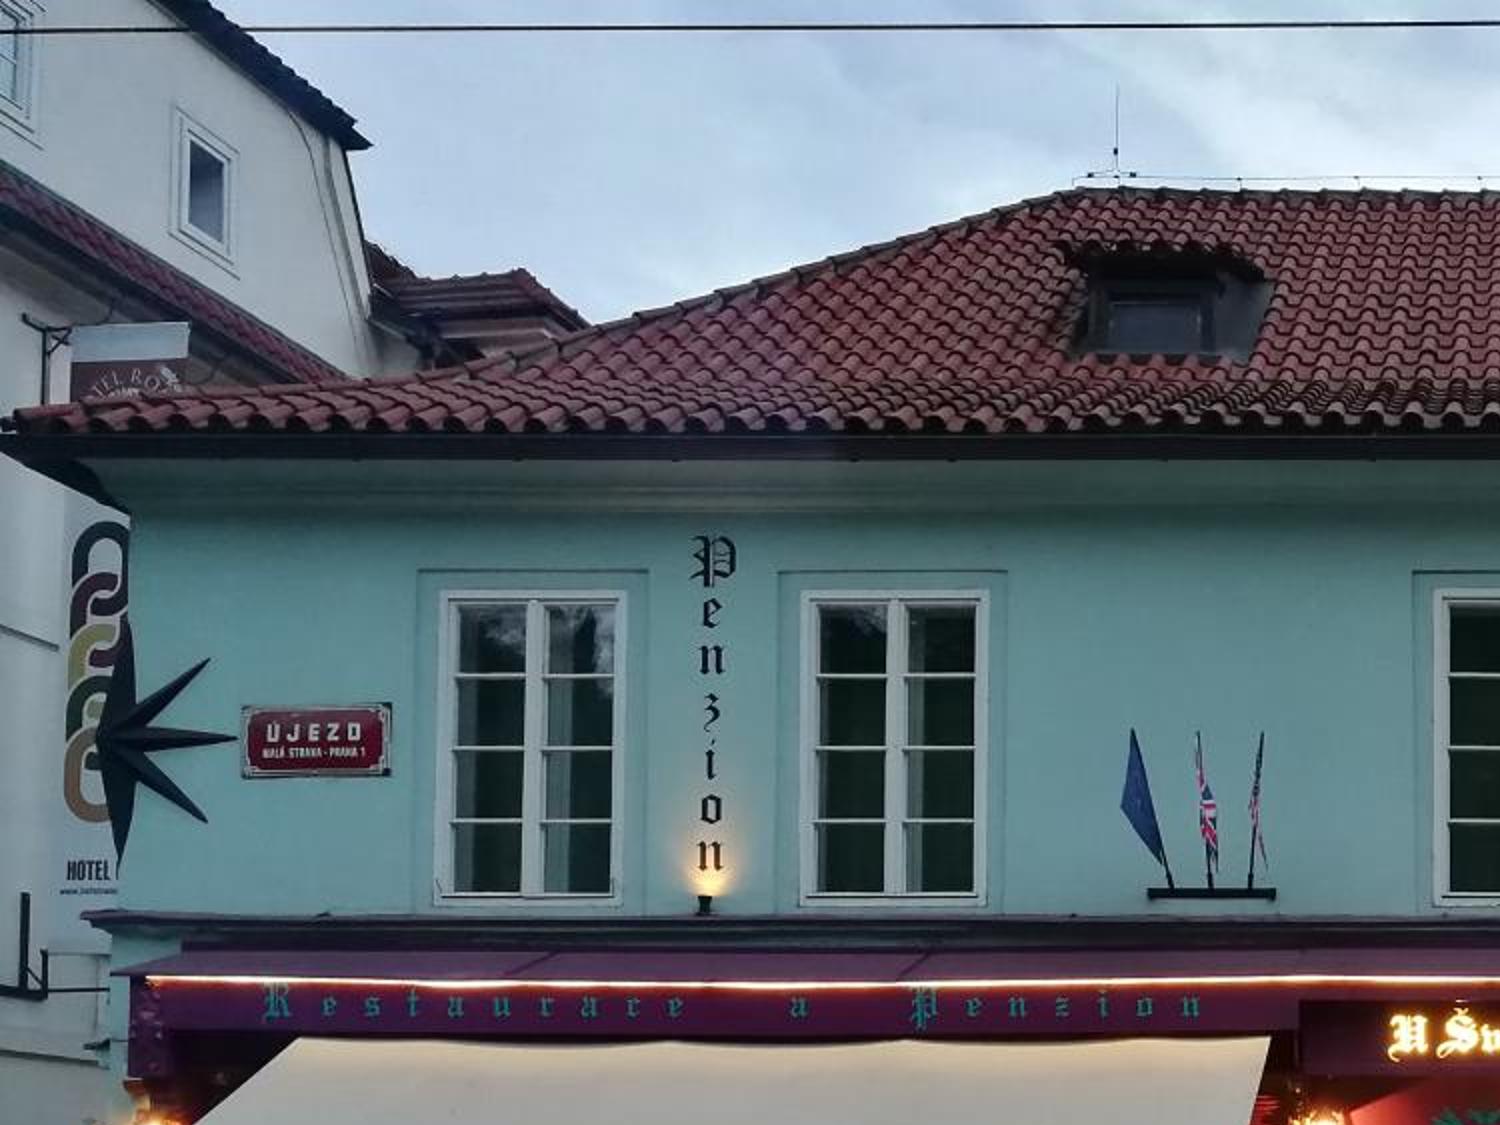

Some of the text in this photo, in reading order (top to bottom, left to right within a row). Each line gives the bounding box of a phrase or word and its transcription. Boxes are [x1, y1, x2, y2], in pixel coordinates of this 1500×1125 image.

[689, 535, 737, 871] Penzion
[266, 720, 361, 742] ÚJEZD
[262, 747, 286, 759] MALÁ
[289, 747, 322, 759] STRANA
[330, 747, 358, 757] PRAHA
[66, 860, 110, 880] HOTEL
